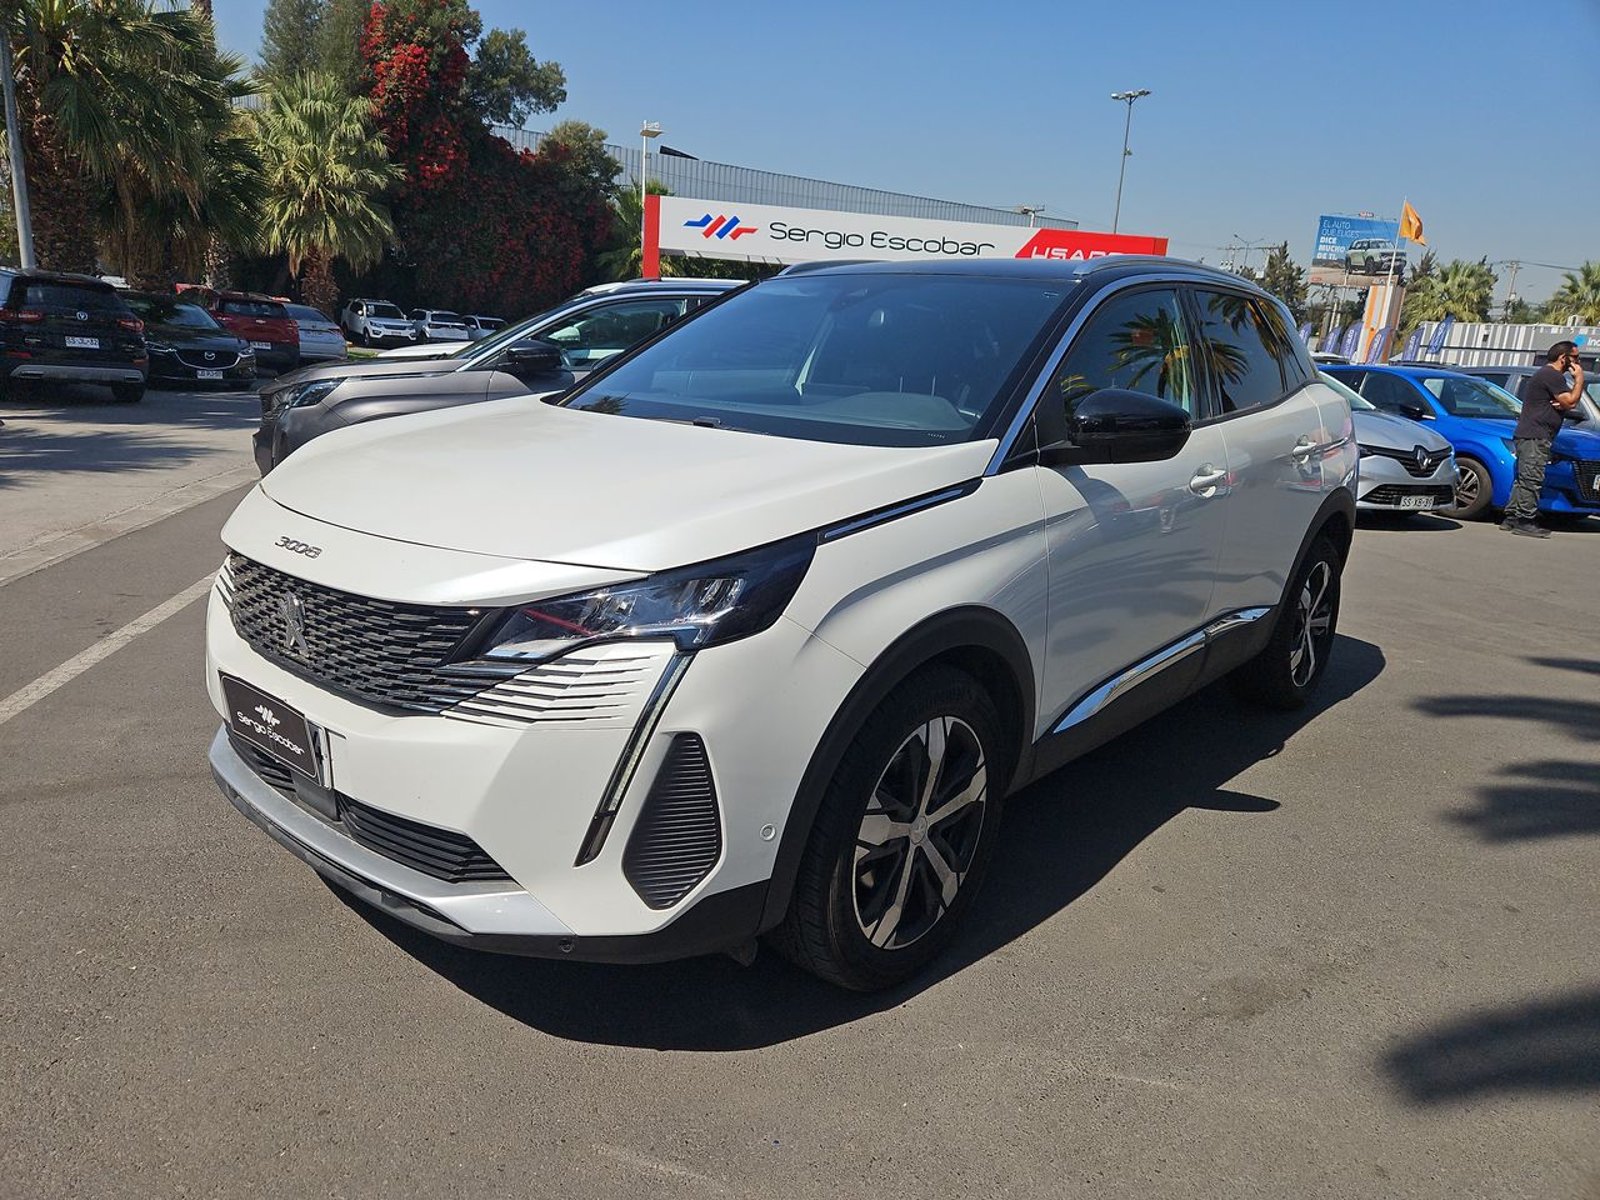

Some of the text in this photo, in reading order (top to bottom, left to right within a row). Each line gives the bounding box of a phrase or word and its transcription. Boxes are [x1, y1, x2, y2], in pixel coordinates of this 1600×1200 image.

[769, 222, 996, 256] Sergio Escobar
[275, 536, 322, 559] 3008
